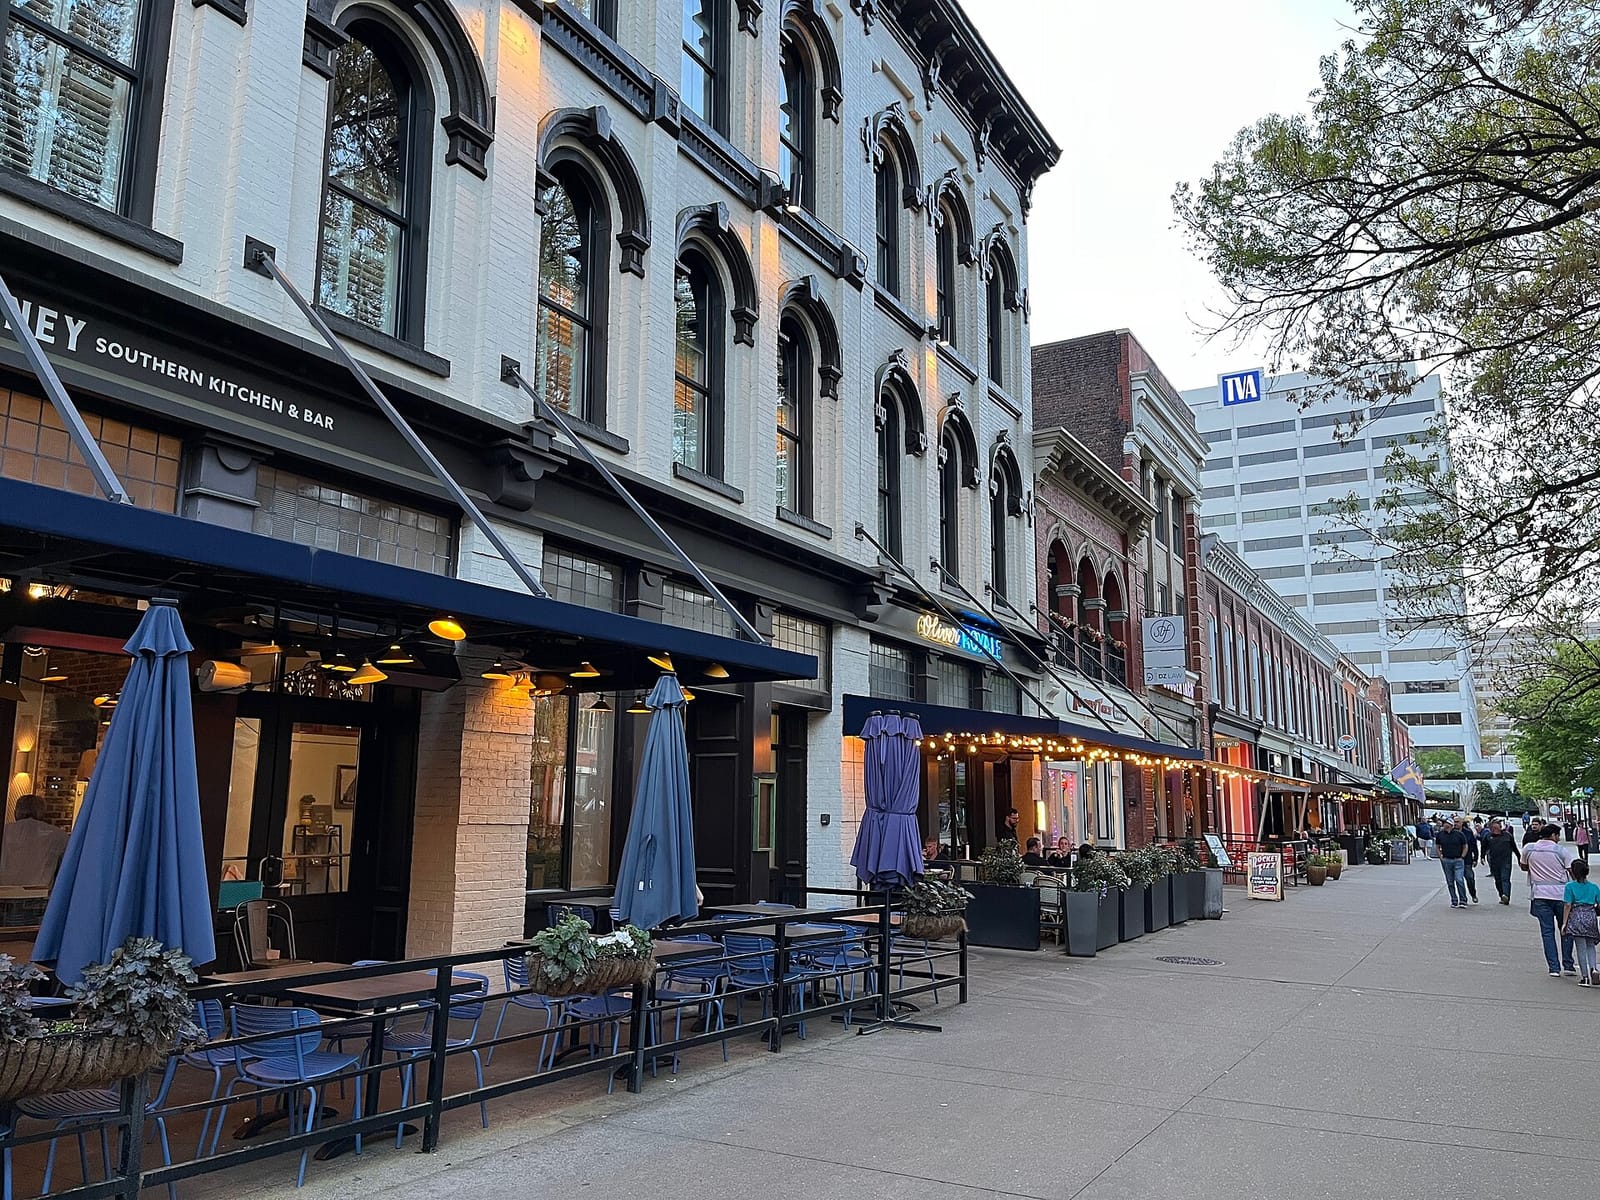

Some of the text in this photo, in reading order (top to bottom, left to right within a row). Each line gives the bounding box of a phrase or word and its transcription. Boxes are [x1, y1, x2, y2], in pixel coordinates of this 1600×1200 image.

[95, 337, 204, 387] SOUTHERN
[208, 376, 284, 414] KITCHEN
[287, 403, 300, 419] &
[303, 408, 334, 431] BAR
[1224, 374, 1258, 402] TVA
[917, 615, 961, 644] Oliver
